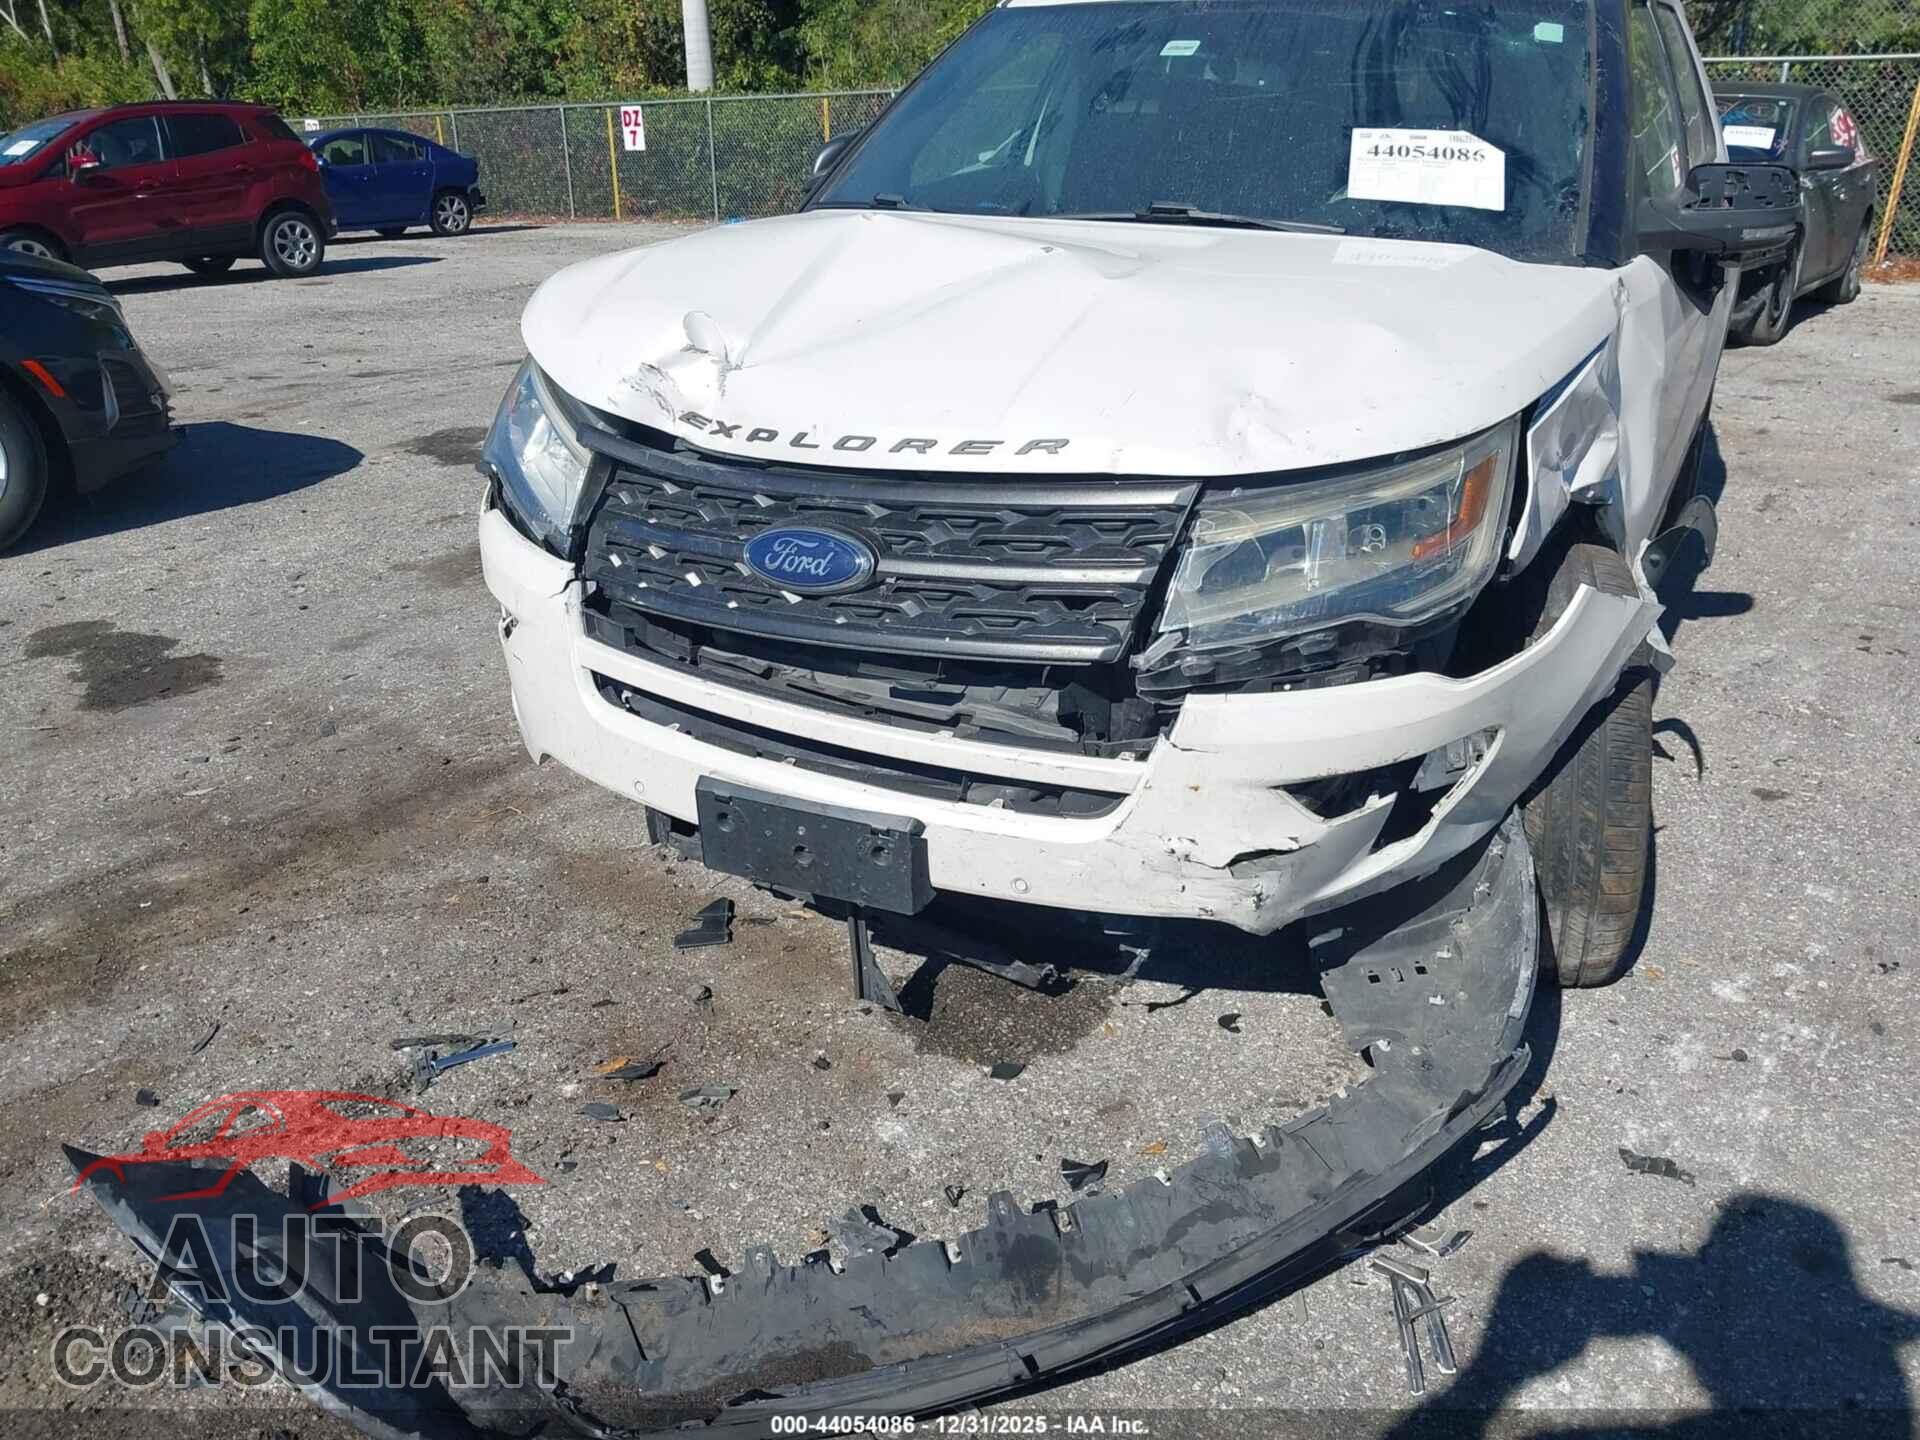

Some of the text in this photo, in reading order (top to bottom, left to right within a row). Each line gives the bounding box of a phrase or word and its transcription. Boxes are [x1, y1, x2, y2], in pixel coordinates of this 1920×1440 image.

[622, 109, 641, 127] DZ
[629, 130, 637, 147] 7
[1367, 144, 1486, 162] 44054086
[677, 410, 1071, 456] EXPLORER
[765, 537, 831, 577] Ford
